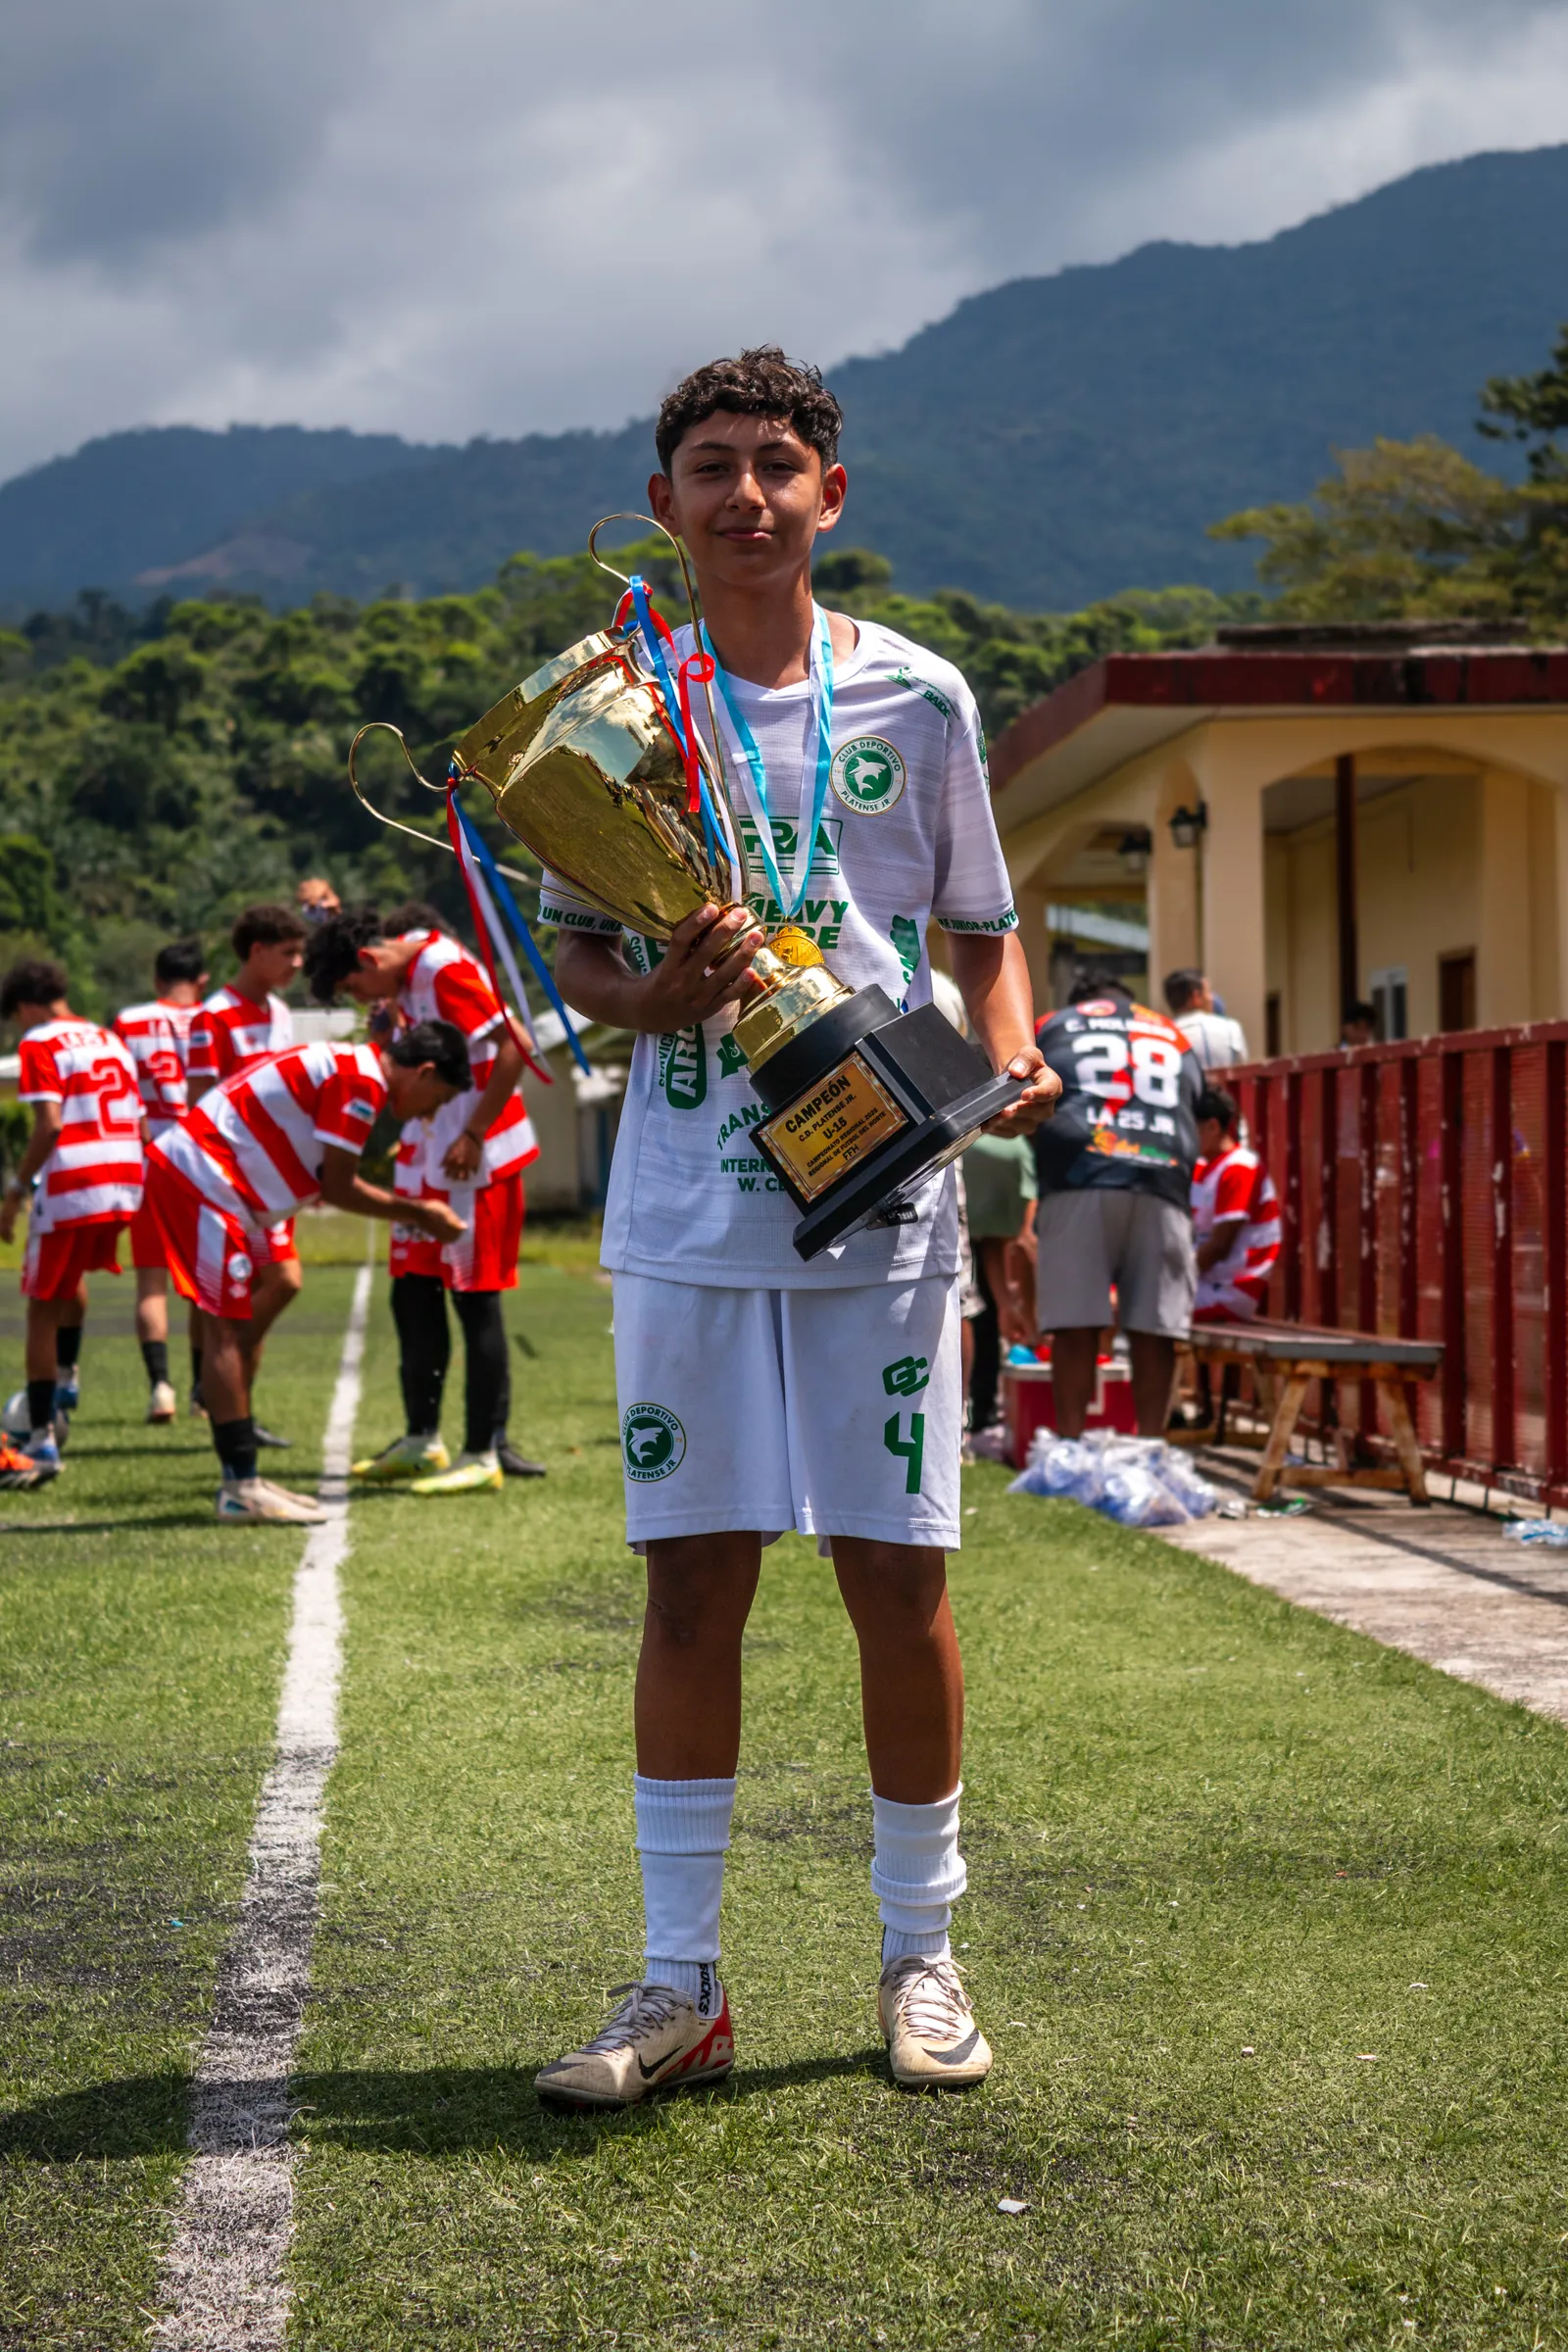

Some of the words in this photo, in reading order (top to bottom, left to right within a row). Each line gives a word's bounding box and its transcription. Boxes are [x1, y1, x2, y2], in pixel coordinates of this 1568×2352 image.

[838, 744, 858, 762] CLUB
[859, 741, 901, 771] DEPORTIVO
[841, 790, 879, 811] PLATENSE
[881, 798, 891, 808] JR
[543, 906, 563, 923] UN
[564, 912, 596, 930] CLUB,
[1071, 1032, 1183, 1108] 28
[785, 1074, 852, 1134] CAMPEÓN
[799, 1129, 813, 1143] C.D.
[811, 1101, 846, 1132] PLATENSE
[845, 1093, 858, 1105] JR.
[822, 1115, 848, 1140] U-15
[1087, 1107, 1114, 1126] LA
[1117, 1109, 1145, 1131] 25
[807, 1138, 841, 1168] CAMPEONATO
[840, 1118, 866, 1141] REGIONAL
[808, 1154, 835, 1177] REGIONAL
[832, 1148, 842, 1157] DE
[858, 1125, 870, 1136] DEL
[868, 1110, 887, 1128] NORTE
[842, 1144, 860, 1161] FFH
[737, 1177, 760, 1192] W.
[630, 1405, 679, 1431] DEPORTIVO
[884, 1410, 925, 1494] 4
[626, 1463, 666, 1480] PLATENSE
[666, 1458, 677, 1471] JR
